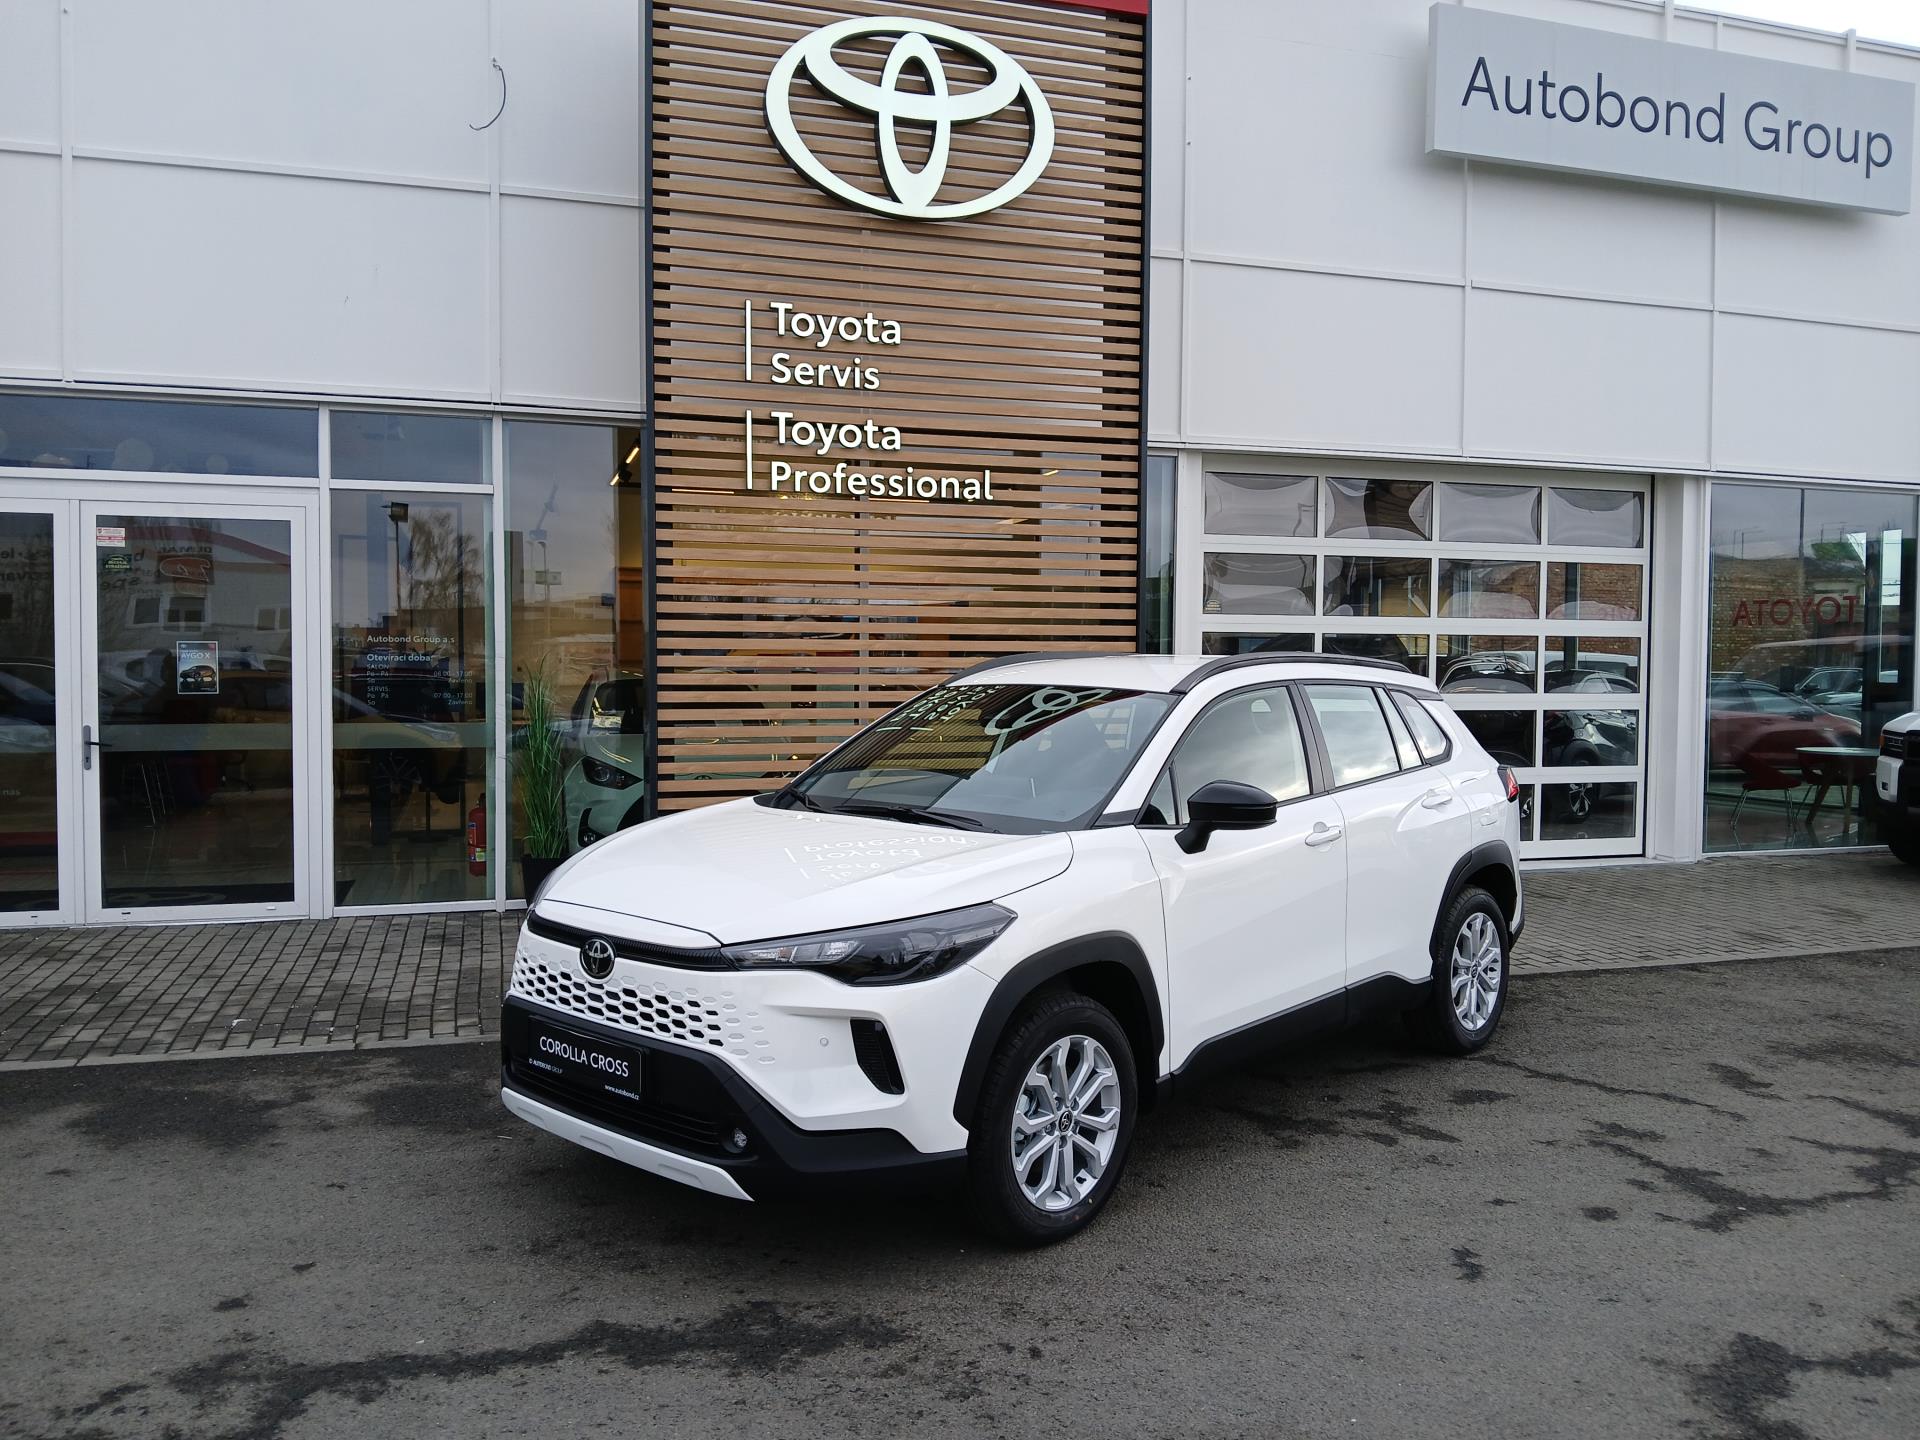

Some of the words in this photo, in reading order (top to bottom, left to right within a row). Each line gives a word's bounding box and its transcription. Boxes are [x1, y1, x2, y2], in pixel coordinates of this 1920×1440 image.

[1462, 56, 1725, 144] Autobond
[1744, 101, 1892, 179] Group
[770, 302, 902, 348] Toyota
[771, 352, 881, 390] Servis
[770, 411, 902, 456] Toyota
[770, 461, 994, 500] Professional
[366, 634, 411, 643] Autobond
[413, 635, 441, 645] Group
[539, 1036, 589, 1065] COROLLA
[590, 1052, 630, 1078] CROSS
